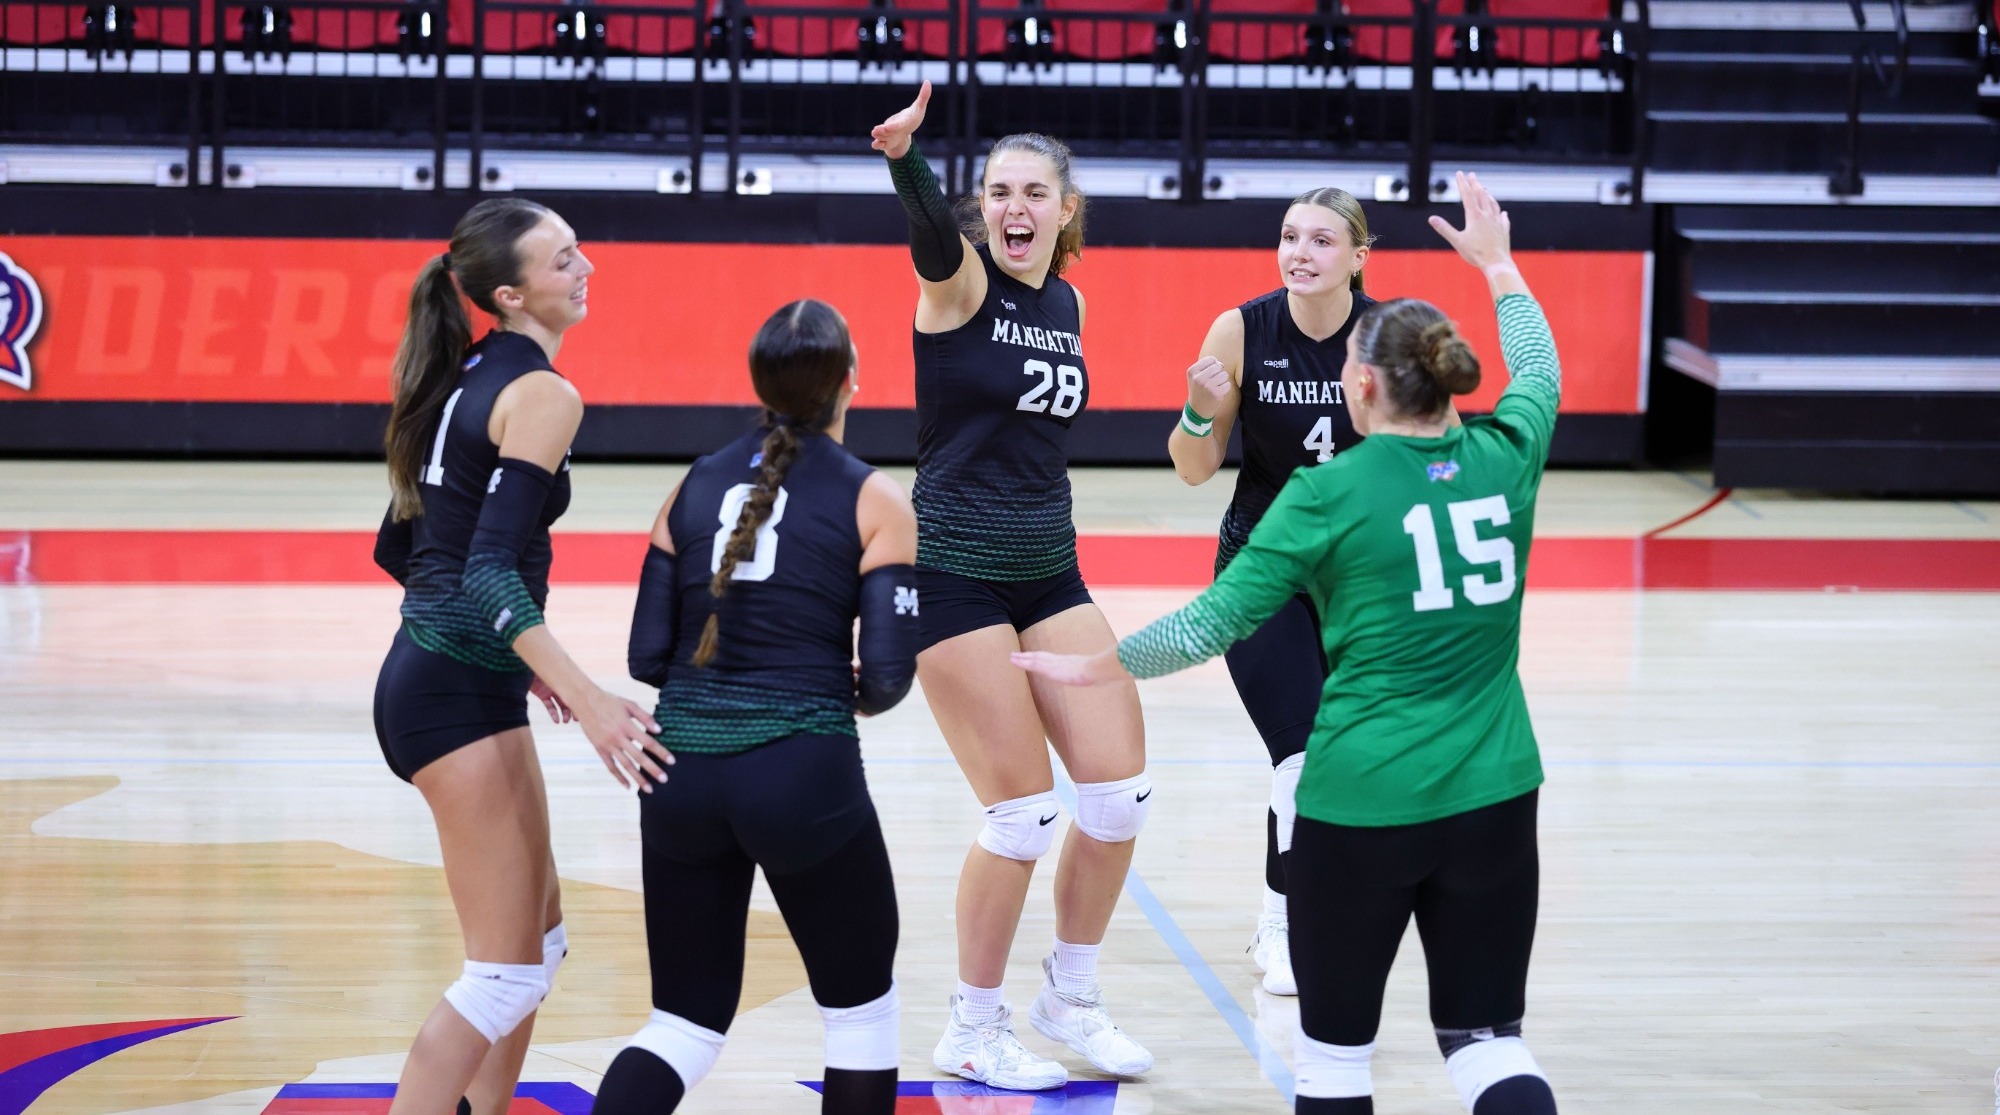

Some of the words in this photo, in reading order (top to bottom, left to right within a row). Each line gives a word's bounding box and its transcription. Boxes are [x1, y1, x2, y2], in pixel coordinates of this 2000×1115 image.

[991, 318, 1083, 357] MANHATTA
[1015, 358, 1084, 418] 28
[1302, 416, 1335, 464] 4
[710, 482, 789, 582] 8
[1402, 494, 1517, 612] 15
